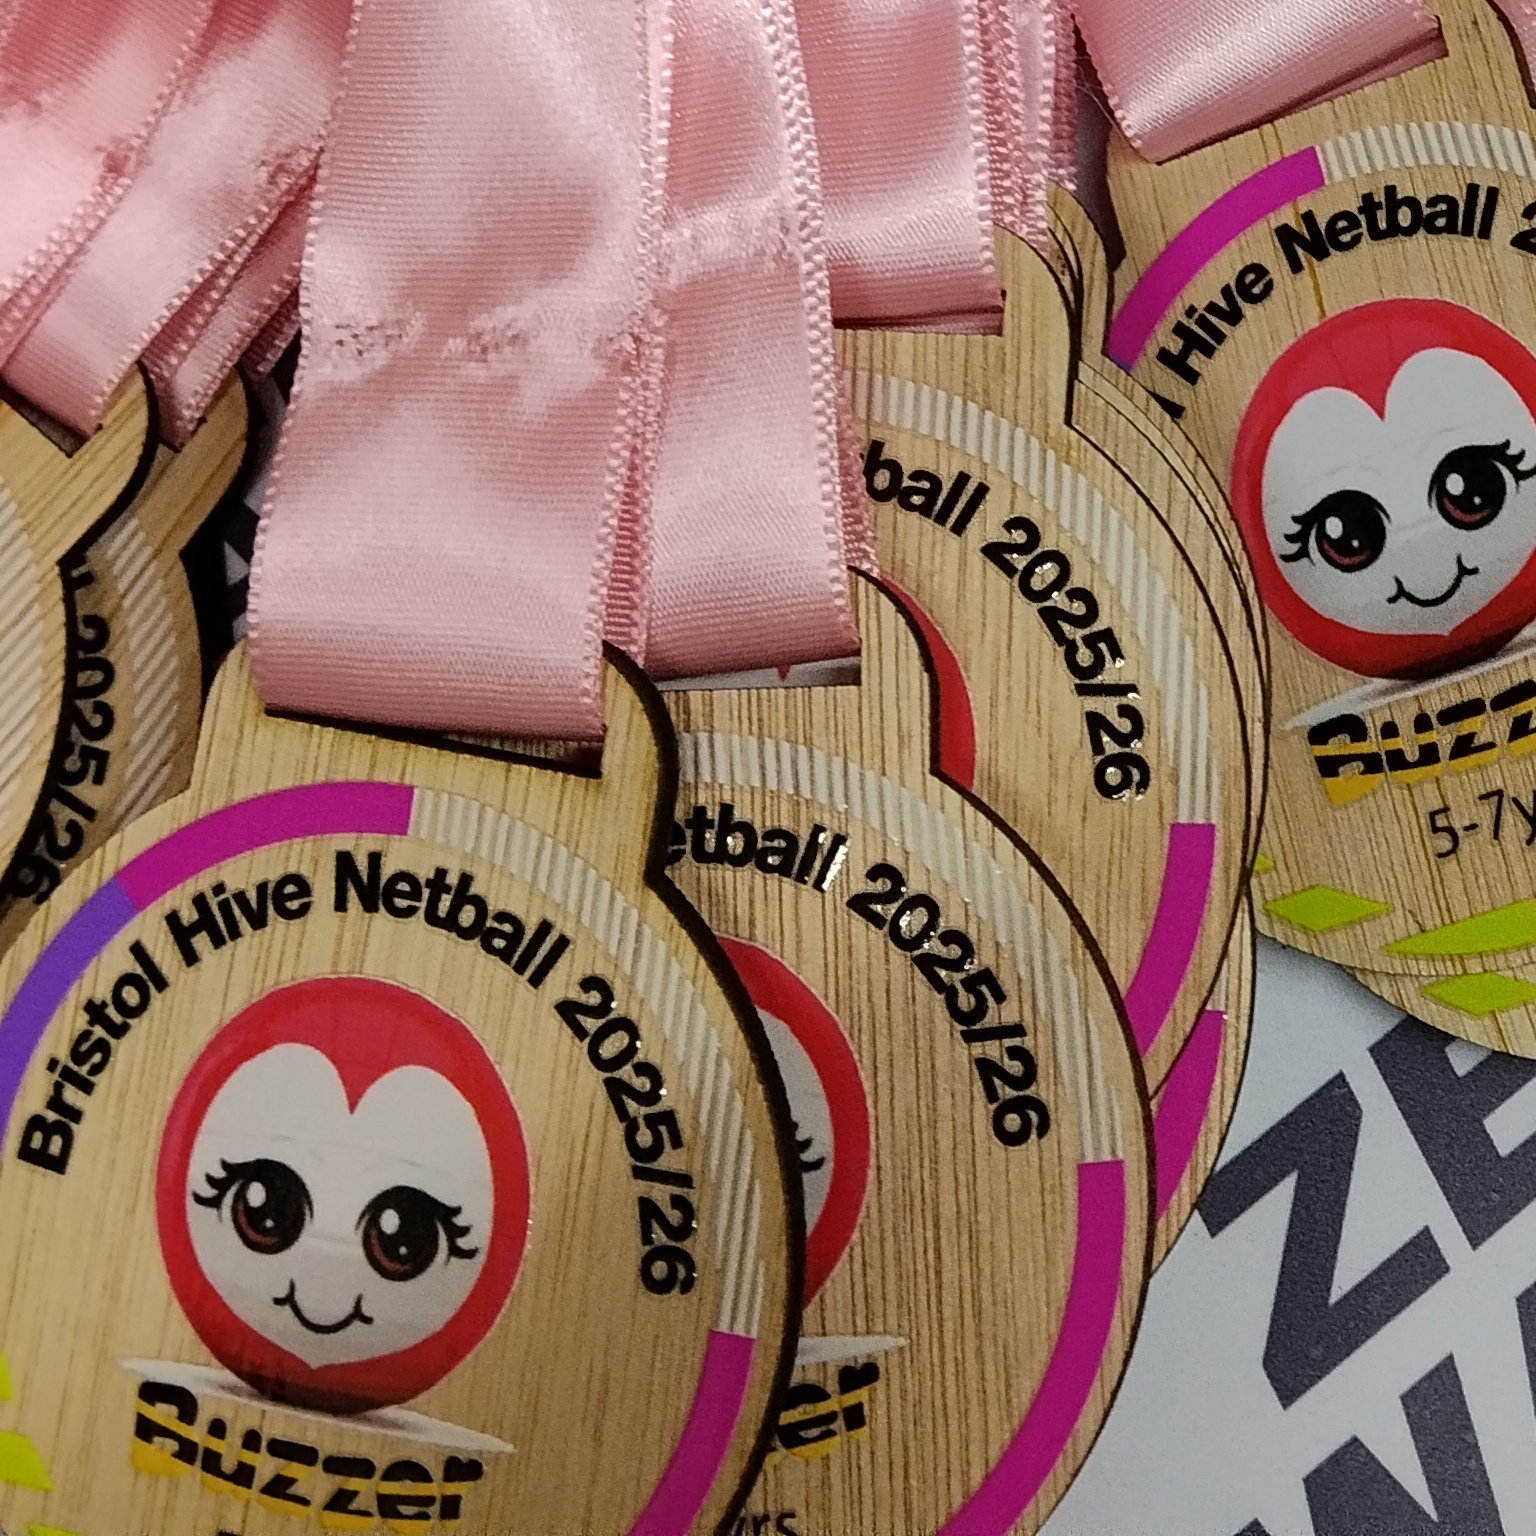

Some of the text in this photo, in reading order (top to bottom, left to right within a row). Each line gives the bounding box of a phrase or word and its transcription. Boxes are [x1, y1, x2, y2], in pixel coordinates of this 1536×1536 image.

[1156, 261, 1274, 386] Hive
[1274, 182, 1500, 276] Netball
[8, 613, 115, 905] 2025/26
[860, 439, 1151, 801] ball 2025/26
[17, 849, 698, 1296] Bristol Hive Netball 2025/26
[847, 862, 1051, 1147] 2025/26
[131, 1379, 485, 1536] Buzzer
[763, 1362, 880, 1469] er
